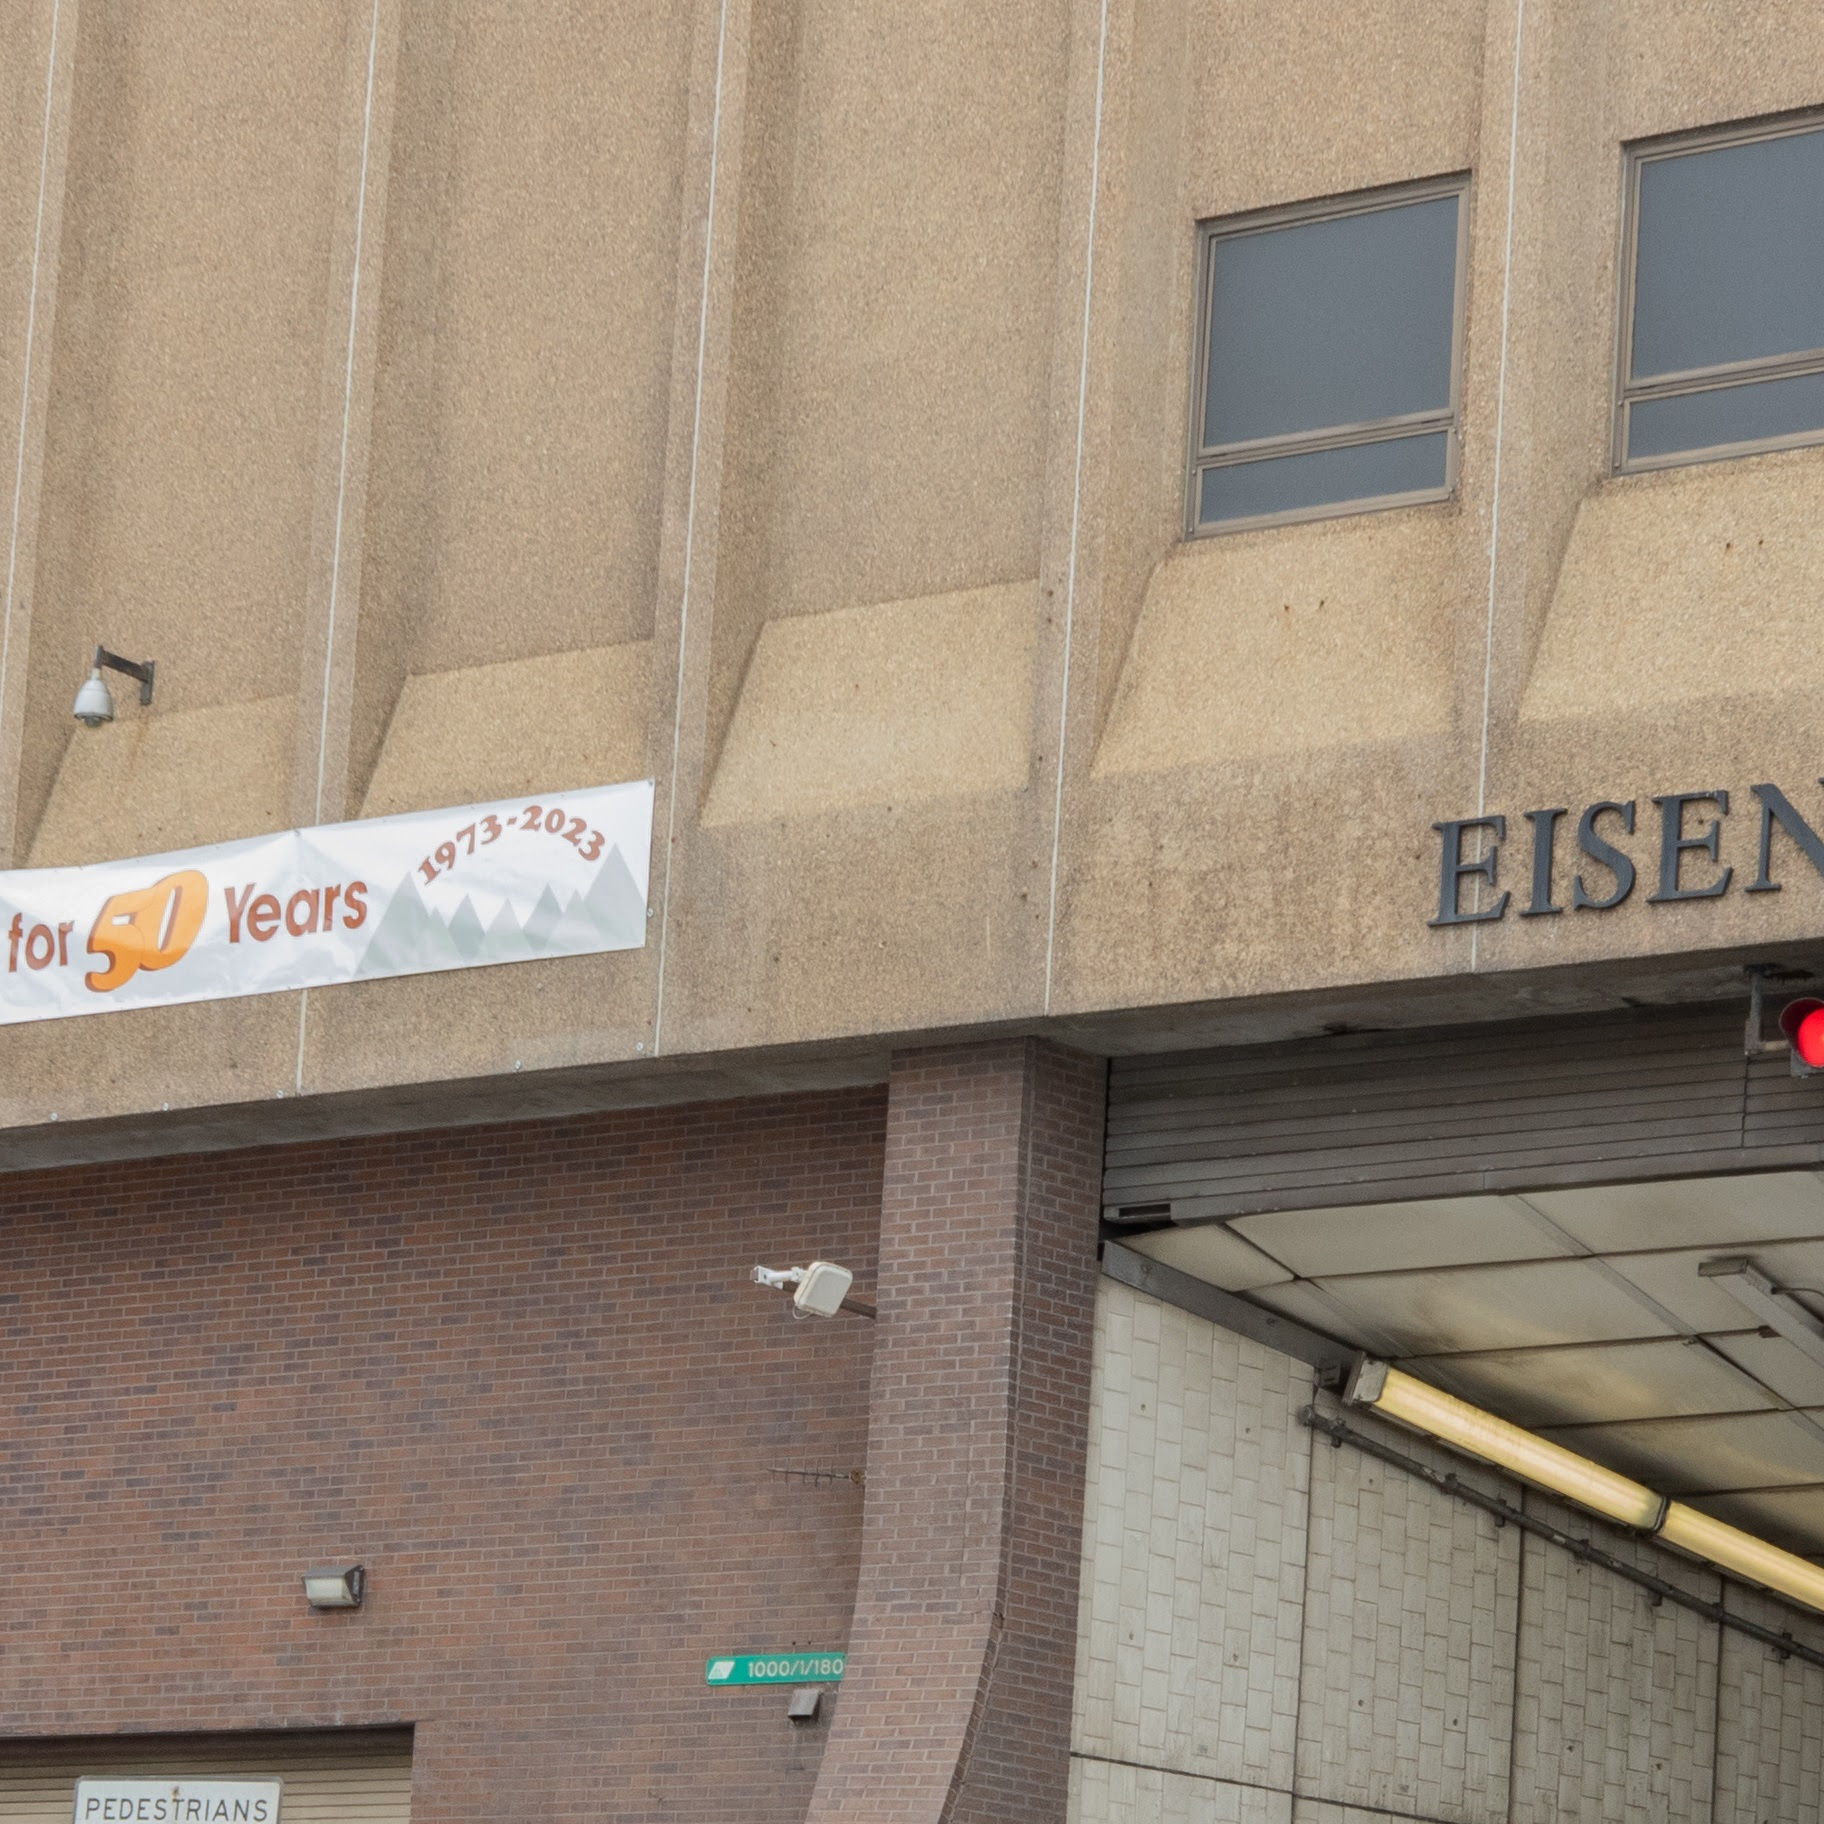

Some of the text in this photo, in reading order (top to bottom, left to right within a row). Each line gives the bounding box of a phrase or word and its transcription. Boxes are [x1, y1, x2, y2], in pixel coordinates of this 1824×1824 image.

[415, 805, 612, 888] 1973-2023
[7, 913, 75, 972] for
[83, 869, 210, 995] 50
[223, 879, 369, 945] Years
[85, 1797, 268, 1823] PEDESTRIANS
